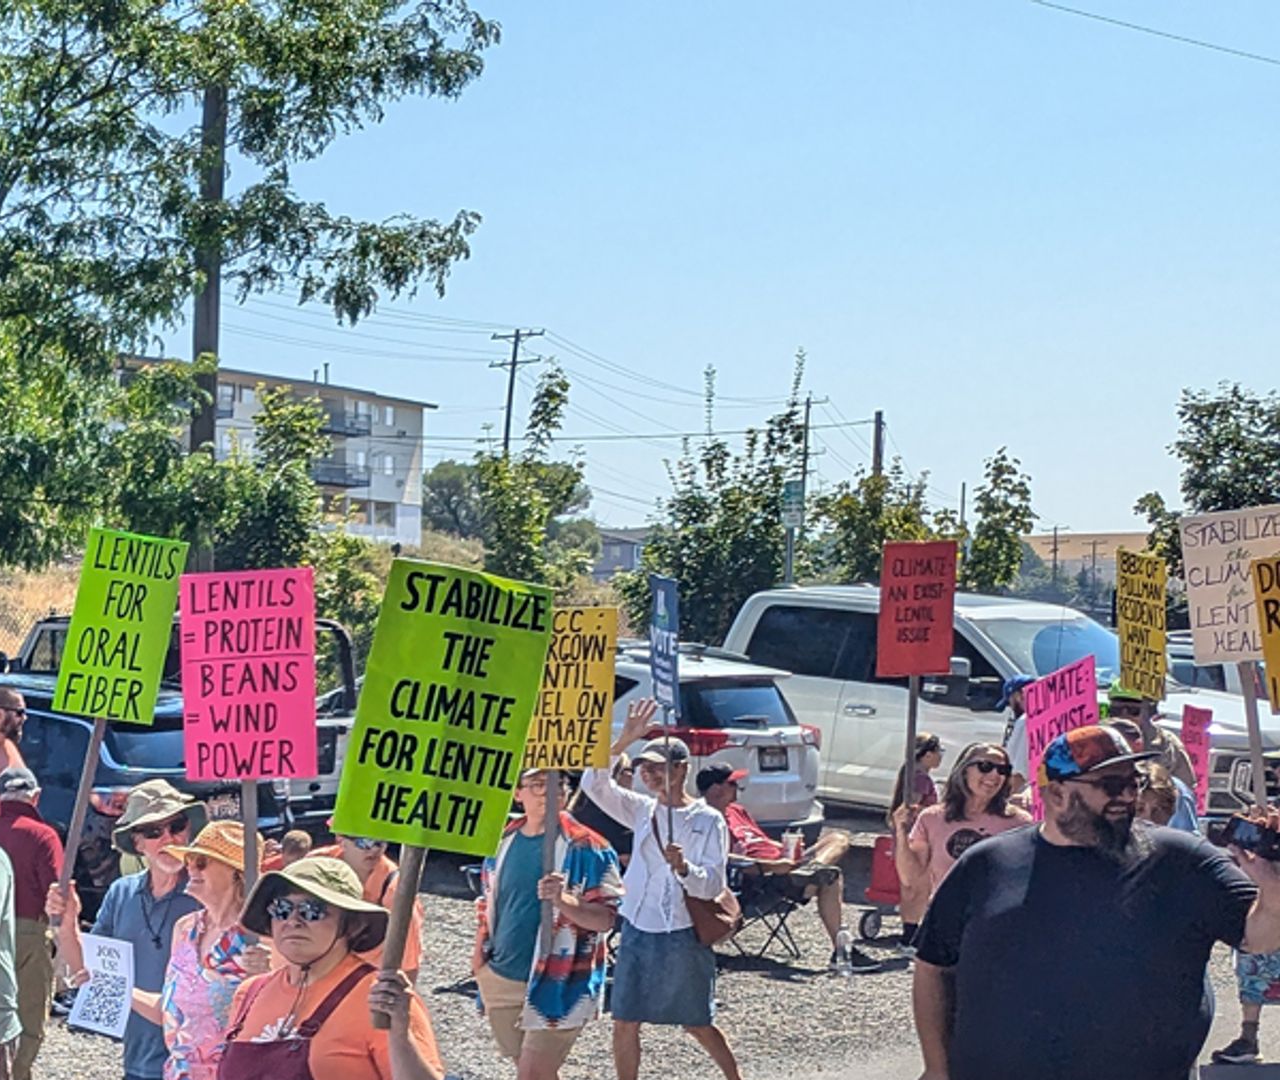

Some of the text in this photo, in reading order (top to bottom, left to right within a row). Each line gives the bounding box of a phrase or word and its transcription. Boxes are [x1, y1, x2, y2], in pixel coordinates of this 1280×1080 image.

[1183, 515, 1280, 548] STABILIZE
[93, 535, 180, 581] LENTILS
[103, 580, 147, 622] FOR
[190, 578, 297, 615] LENTILS
[401, 571, 547, 632] STABILIZE
[888, 585, 907, 600] AN
[552, 610, 584, 634] CC
[1196, 601, 1255, 629] LENT
[77, 627, 142, 672] ORAL
[204, 616, 303, 654] PROTEIN
[1213, 631, 1263, 654] HEAL
[441, 632, 495, 678] THE
[200, 661, 300, 698] BEANS
[543, 663, 593, 689] NTIL
[62, 672, 144, 720] FIBER
[389, 679, 516, 736] CLIMATE
[576, 691, 608, 718] ON
[209, 702, 278, 733] WIND
[197, 740, 296, 778] POWER
[358, 727, 513, 791] FOR LENTIL
[523, 744, 595, 768] HANGE
[370, 781, 483, 837] HEALTH
[96, 945, 122, 959] JOIN
